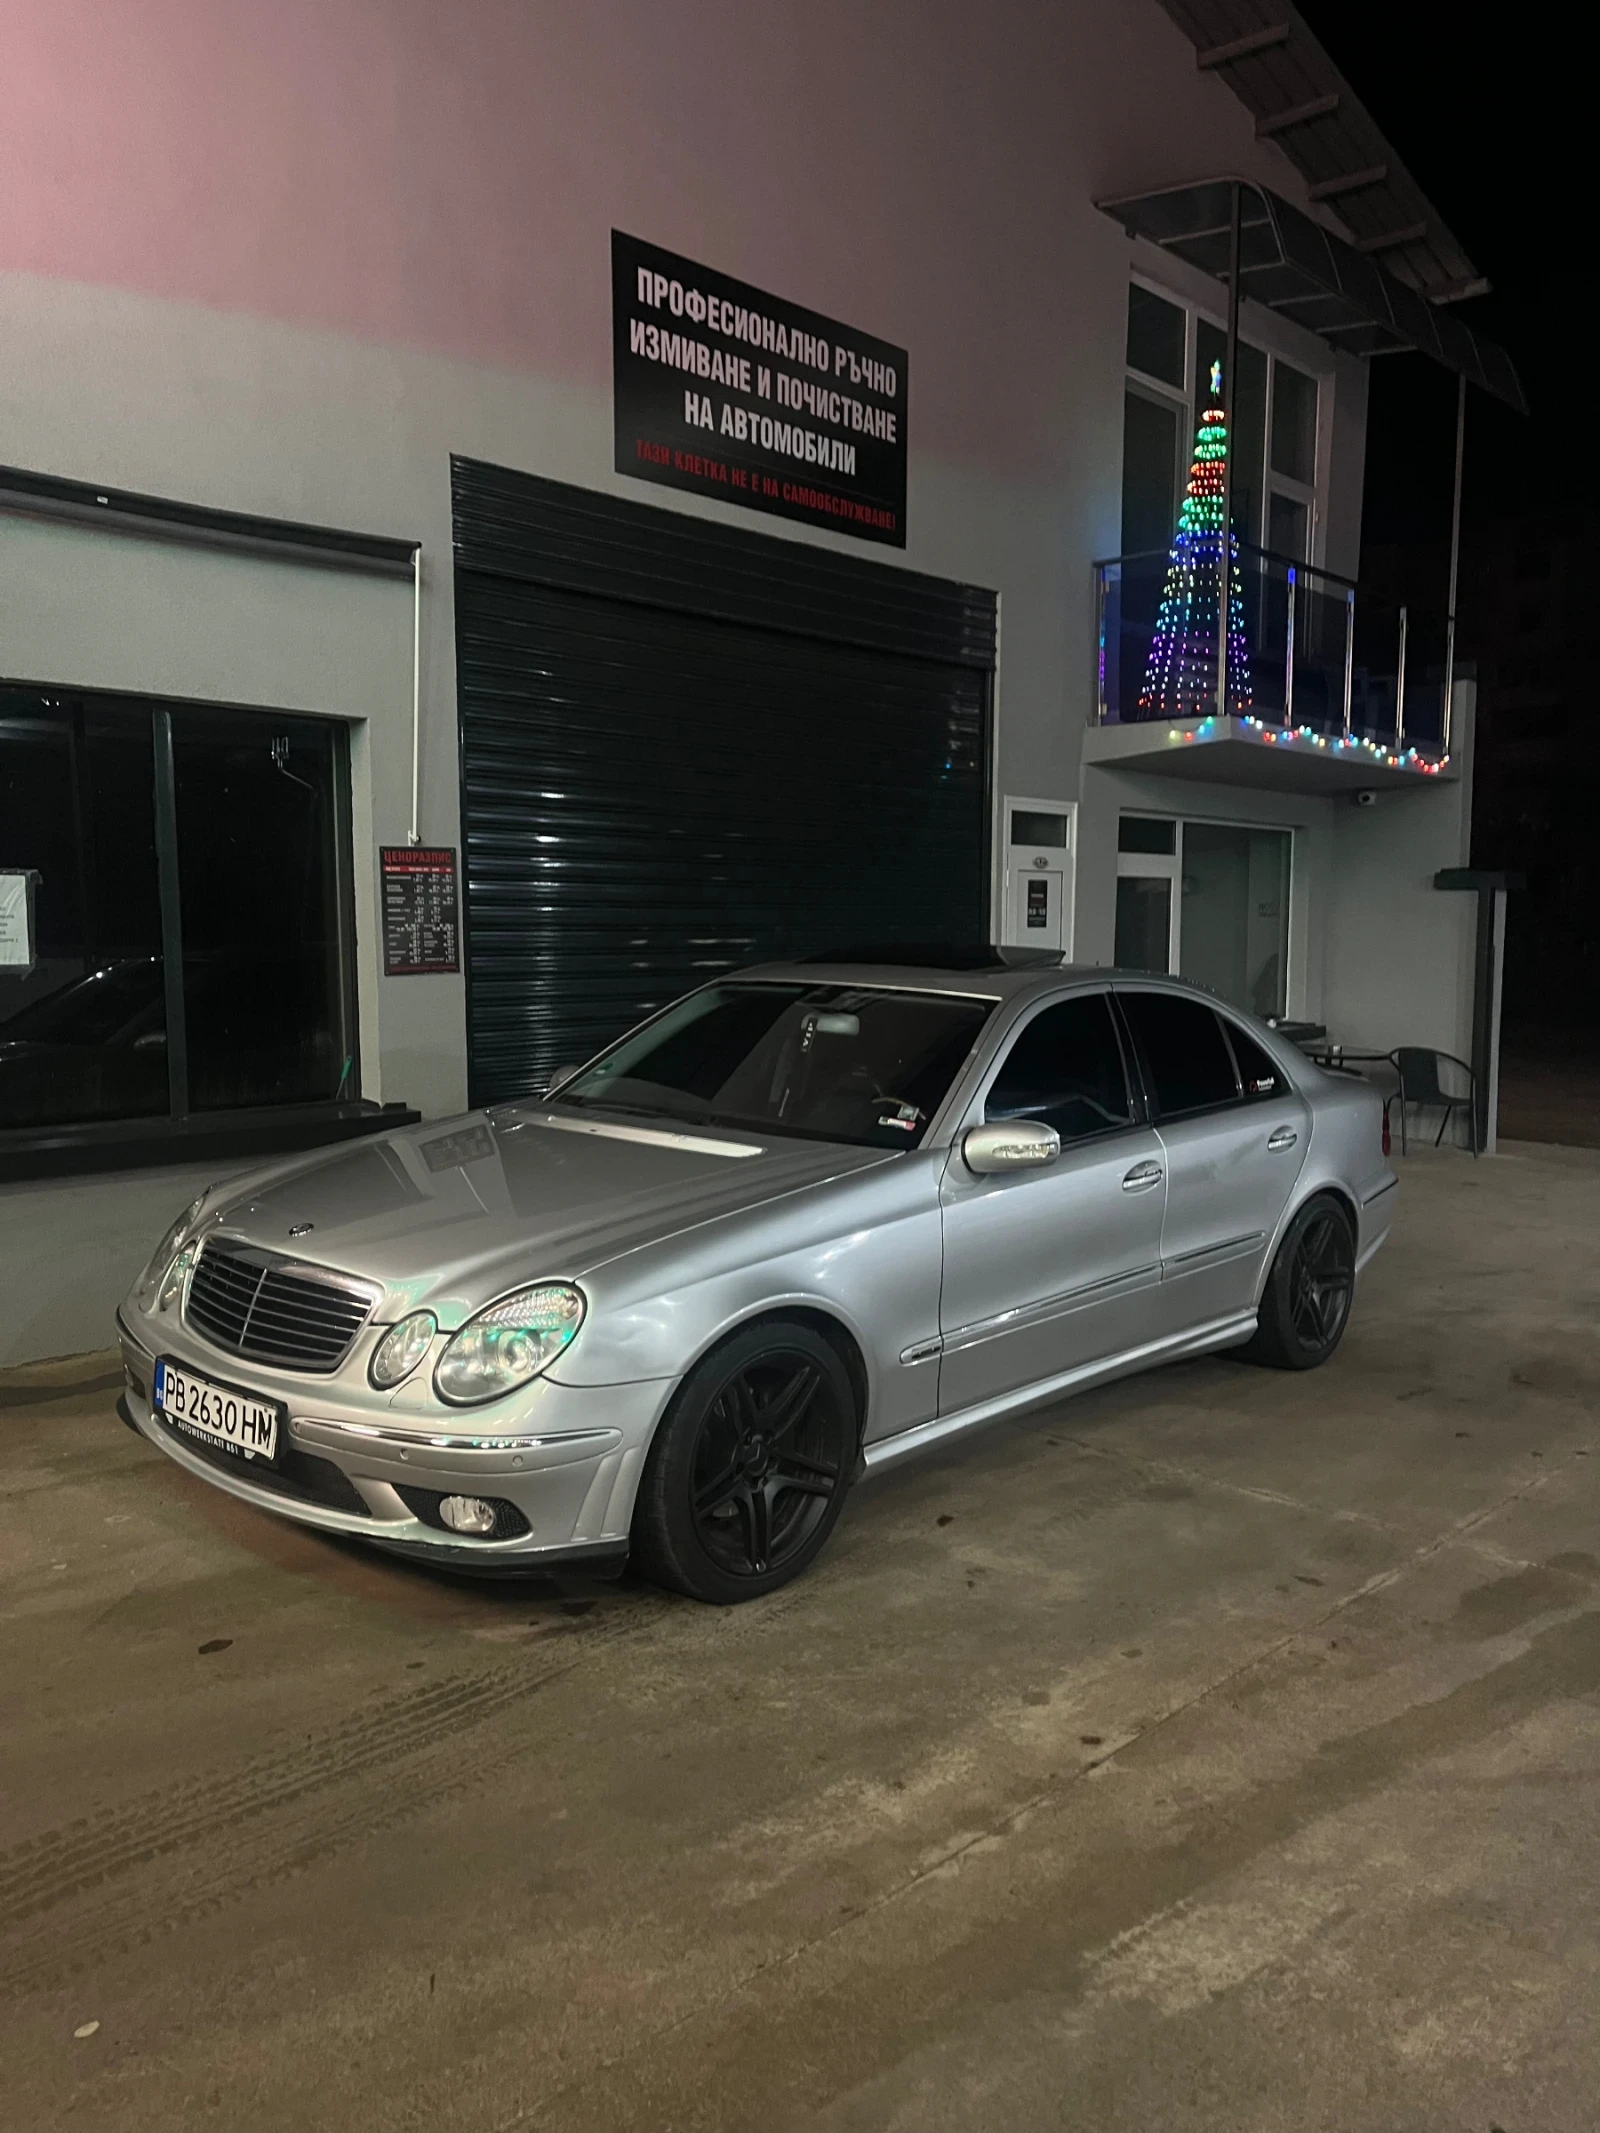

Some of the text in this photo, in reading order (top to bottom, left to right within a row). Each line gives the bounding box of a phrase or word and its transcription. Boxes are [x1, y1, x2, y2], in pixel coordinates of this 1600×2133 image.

[637, 265, 896, 398] ПРОФЕСИОНАЛНО РЪЧНО
[630, 317, 896, 444] ИЗМИВАНЕ И ПОЧИСТВАНЕ
[684, 390, 856, 476] НА АВТОМОБИЛИ
[636, 439, 896, 530] ТАЗИ КЛЕТКА НЕ Е НА САМООБСЛУЖВАНЕ!
[189, 1384, 237, 1435] 2630
